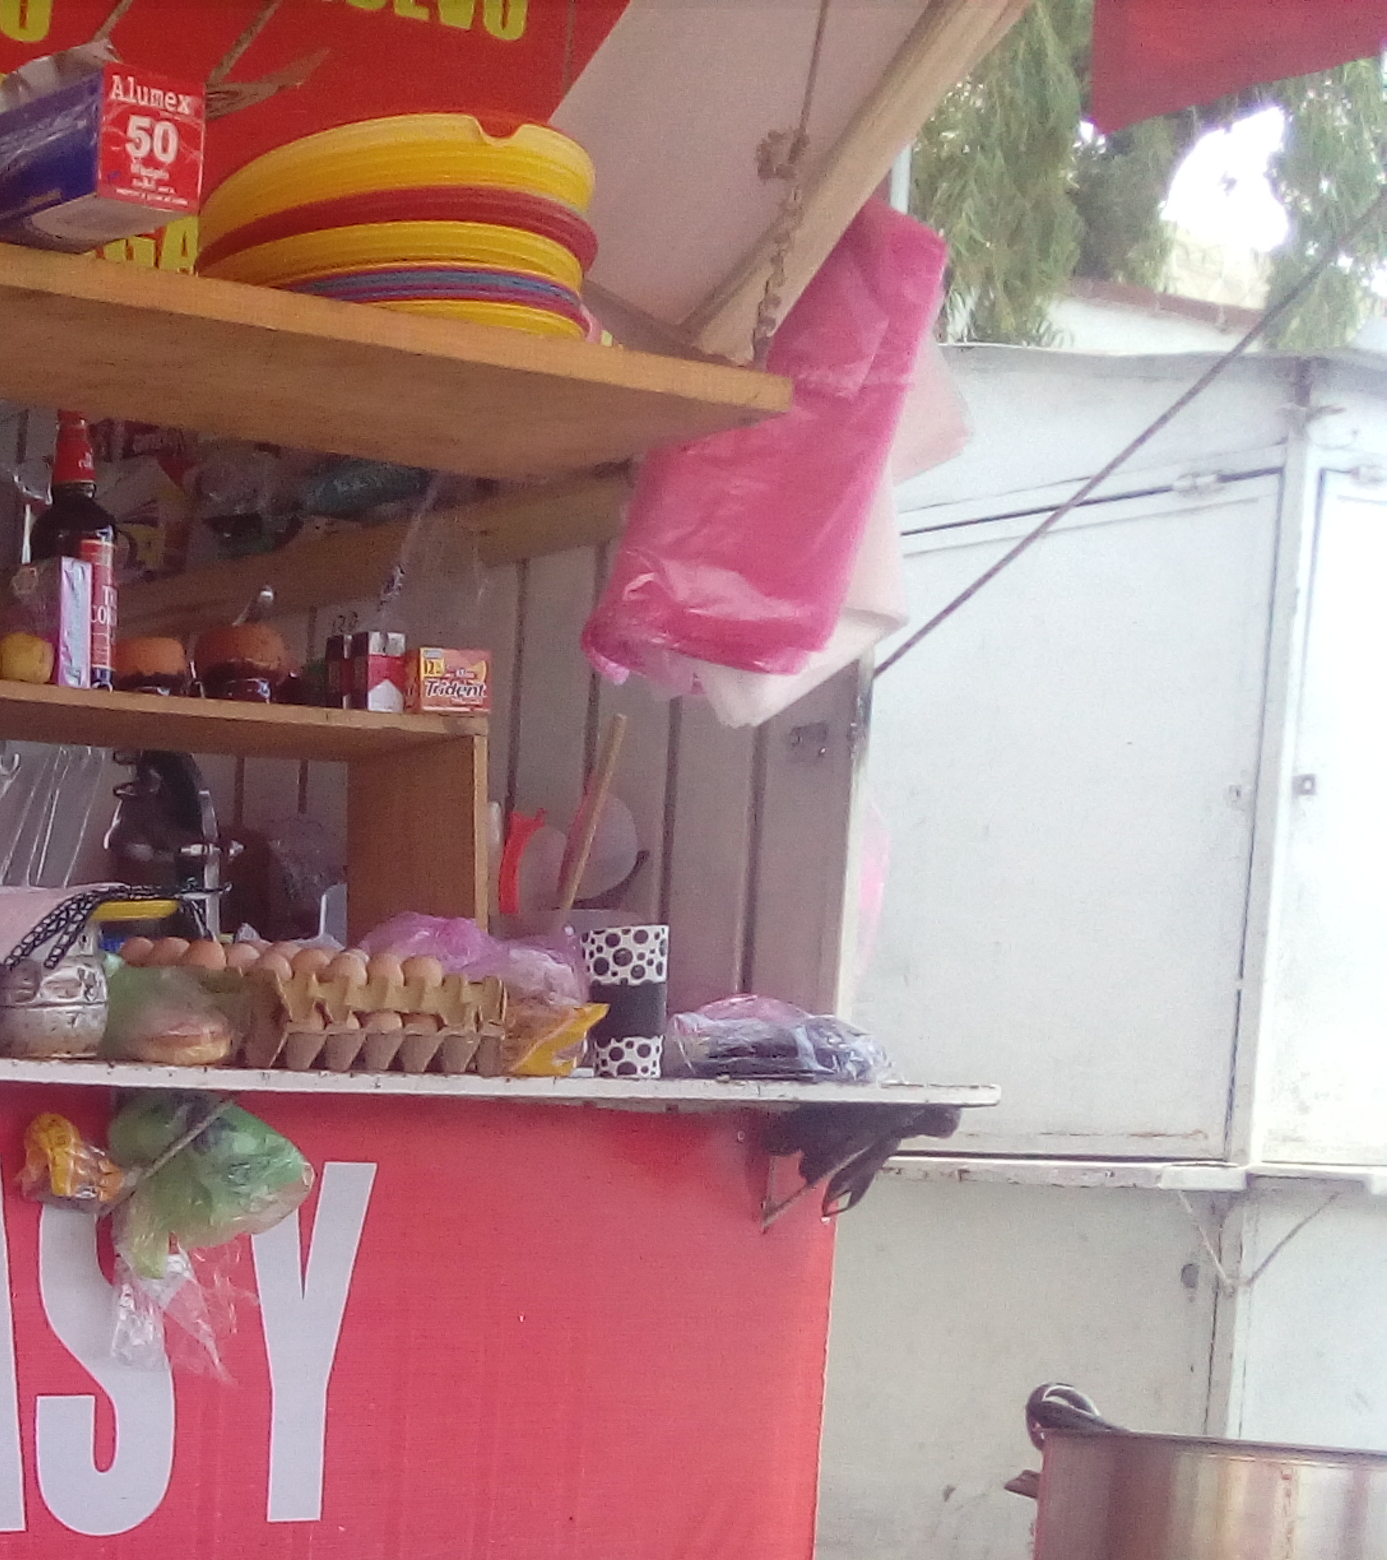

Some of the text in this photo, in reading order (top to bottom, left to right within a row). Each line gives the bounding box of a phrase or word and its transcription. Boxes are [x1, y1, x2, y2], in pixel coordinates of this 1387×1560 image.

[111, 74, 193, 114] Alumex
[125, 114, 178, 164] 50
[426, 680, 485, 698] Trident
[251, 1162, 376, 1523] Y
